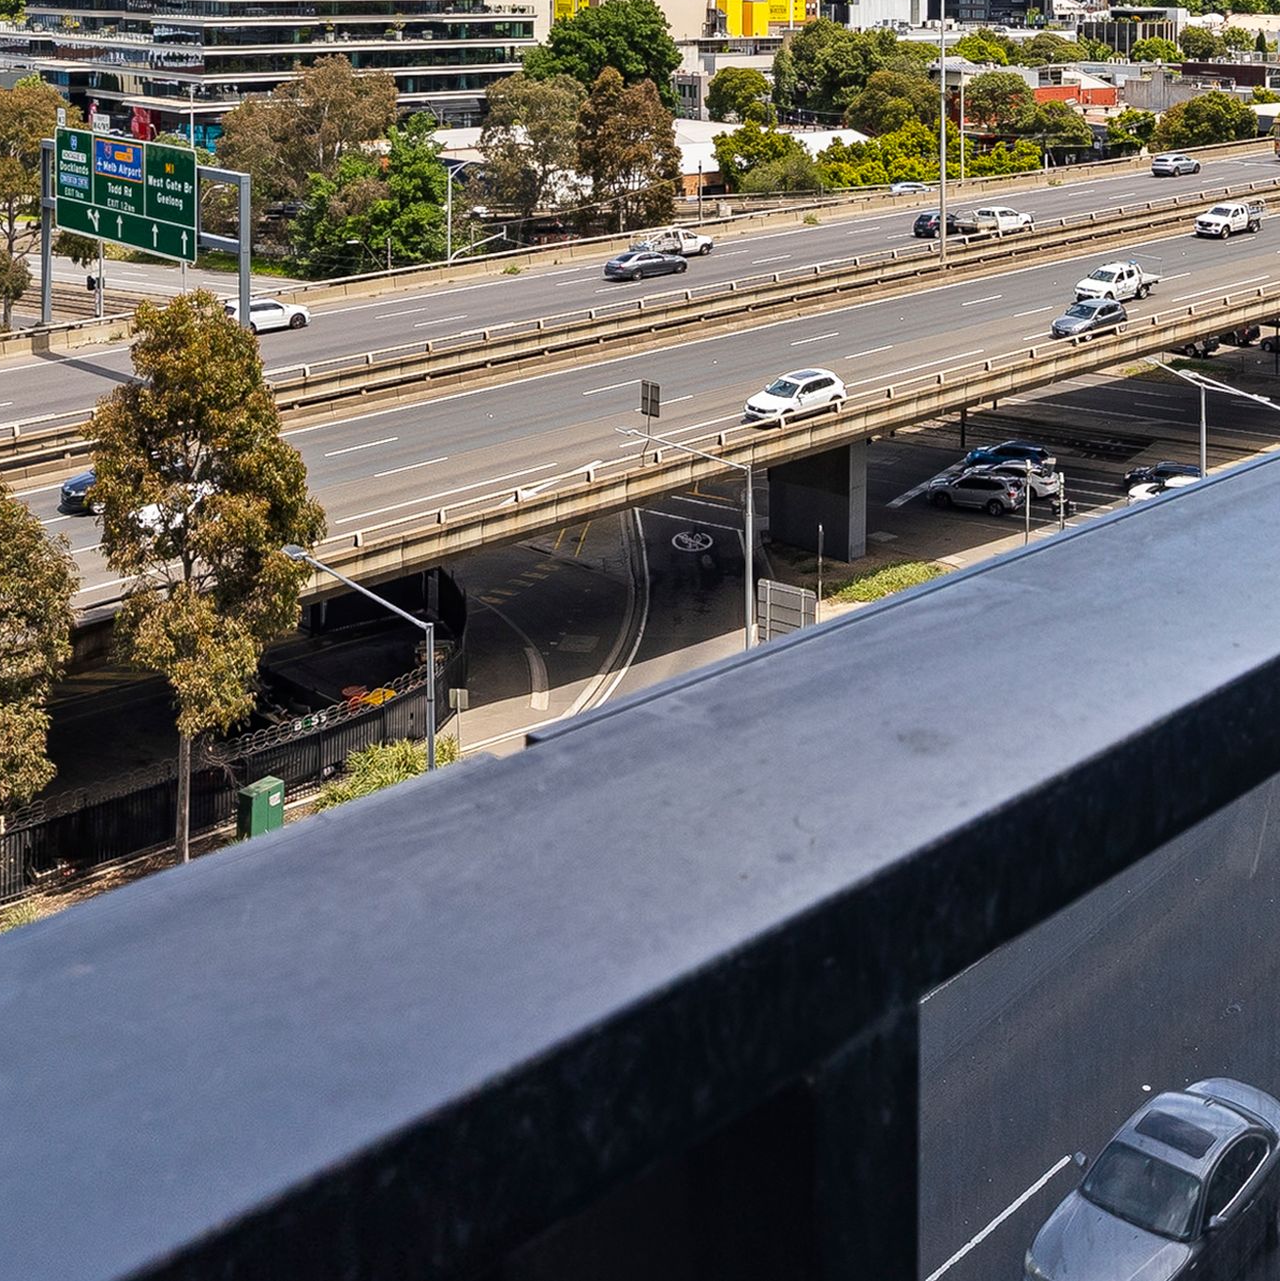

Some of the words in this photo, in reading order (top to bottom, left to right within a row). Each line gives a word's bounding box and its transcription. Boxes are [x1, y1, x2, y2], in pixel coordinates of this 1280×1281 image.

[60, 160, 89, 175] Docklands
[103, 160, 118, 173] Melb
[118, 163, 142, 178] Airport
[107, 182, 122, 196] Todd
[123, 185, 132, 198] Rd
[147, 174, 164, 188] West
[165, 178, 182, 192] Gate
[183, 182, 193, 194] Br
[156, 192, 183, 211] Geelong
